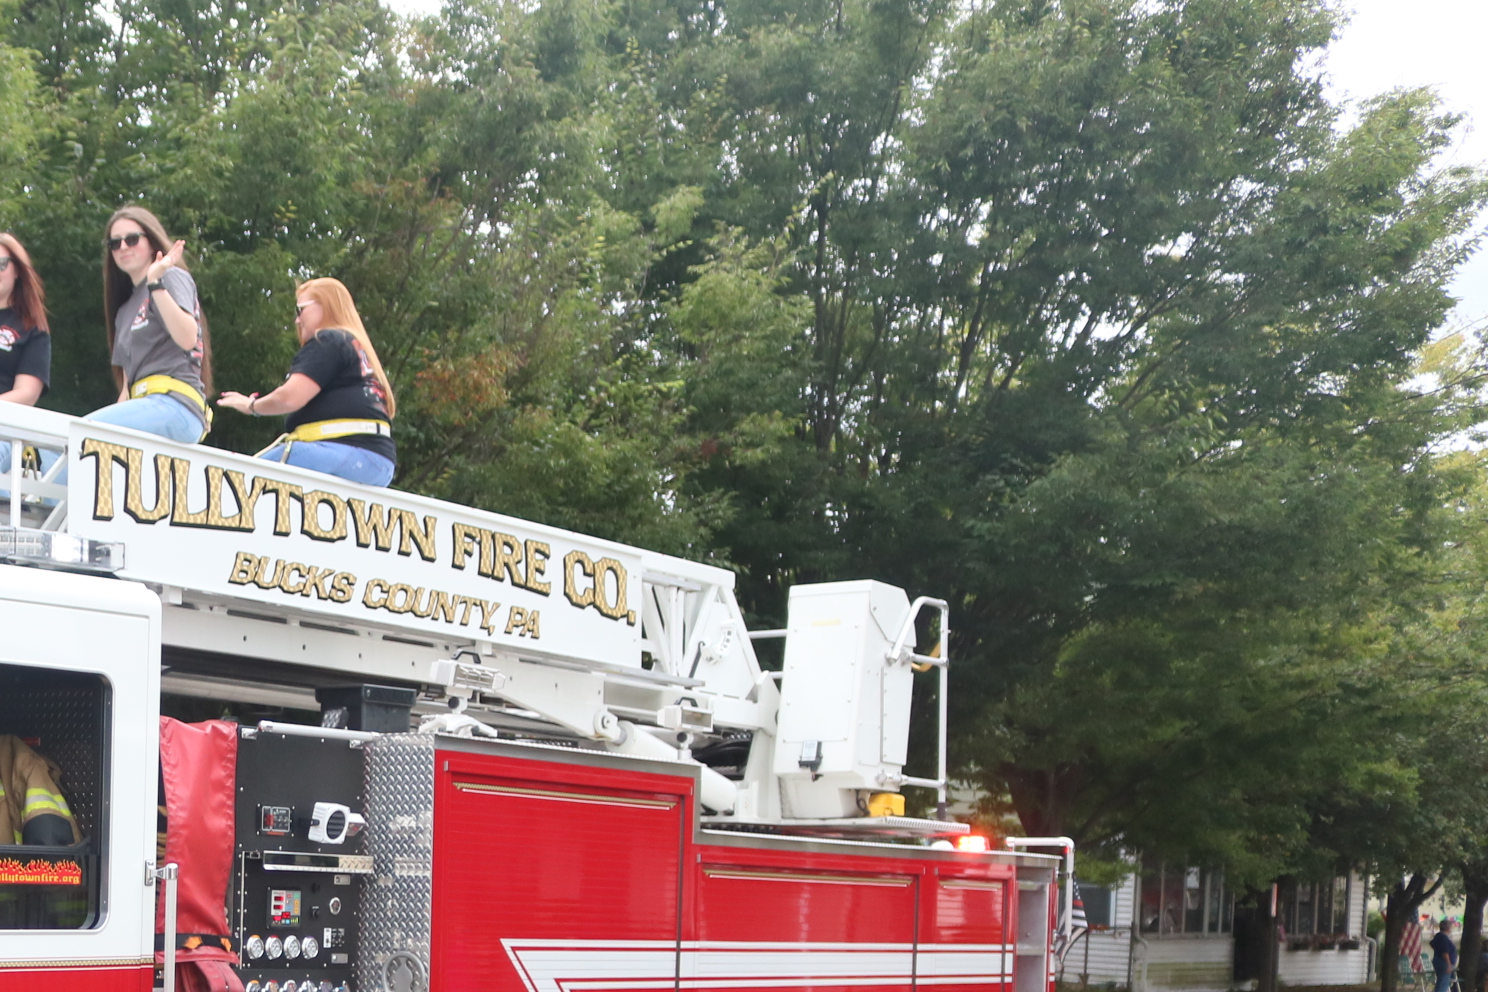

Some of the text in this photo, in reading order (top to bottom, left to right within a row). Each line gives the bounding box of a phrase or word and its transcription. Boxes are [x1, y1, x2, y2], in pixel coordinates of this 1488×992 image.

[80, 437, 637, 626] TULLYTOWN FIRE CO.
[228, 551, 541, 639] BUCKS COUNTY, PA
